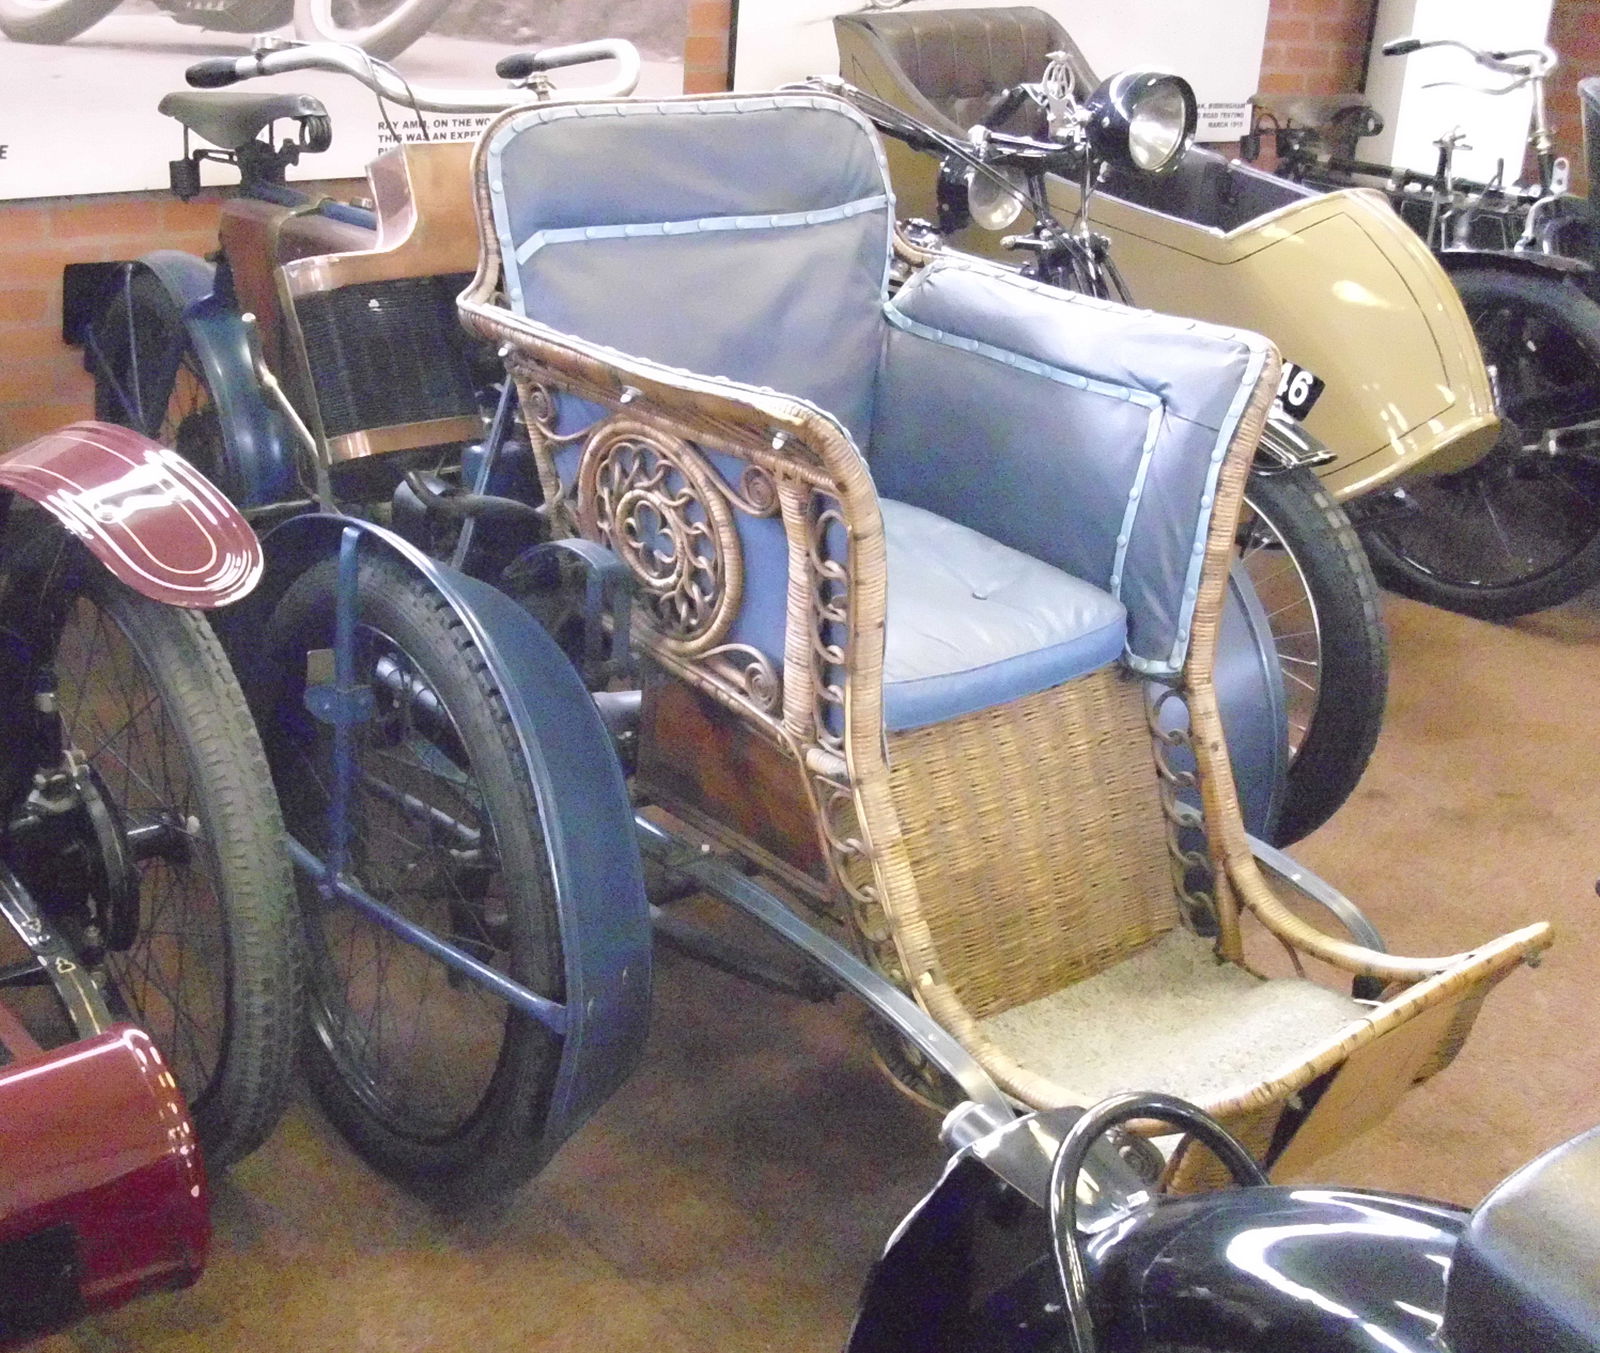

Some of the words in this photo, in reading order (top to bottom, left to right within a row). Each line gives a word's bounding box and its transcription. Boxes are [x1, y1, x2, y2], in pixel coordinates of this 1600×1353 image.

[433, 119, 448, 128] ON
[452, 119, 471, 127] THE
[433, 132, 446, 140] AN
